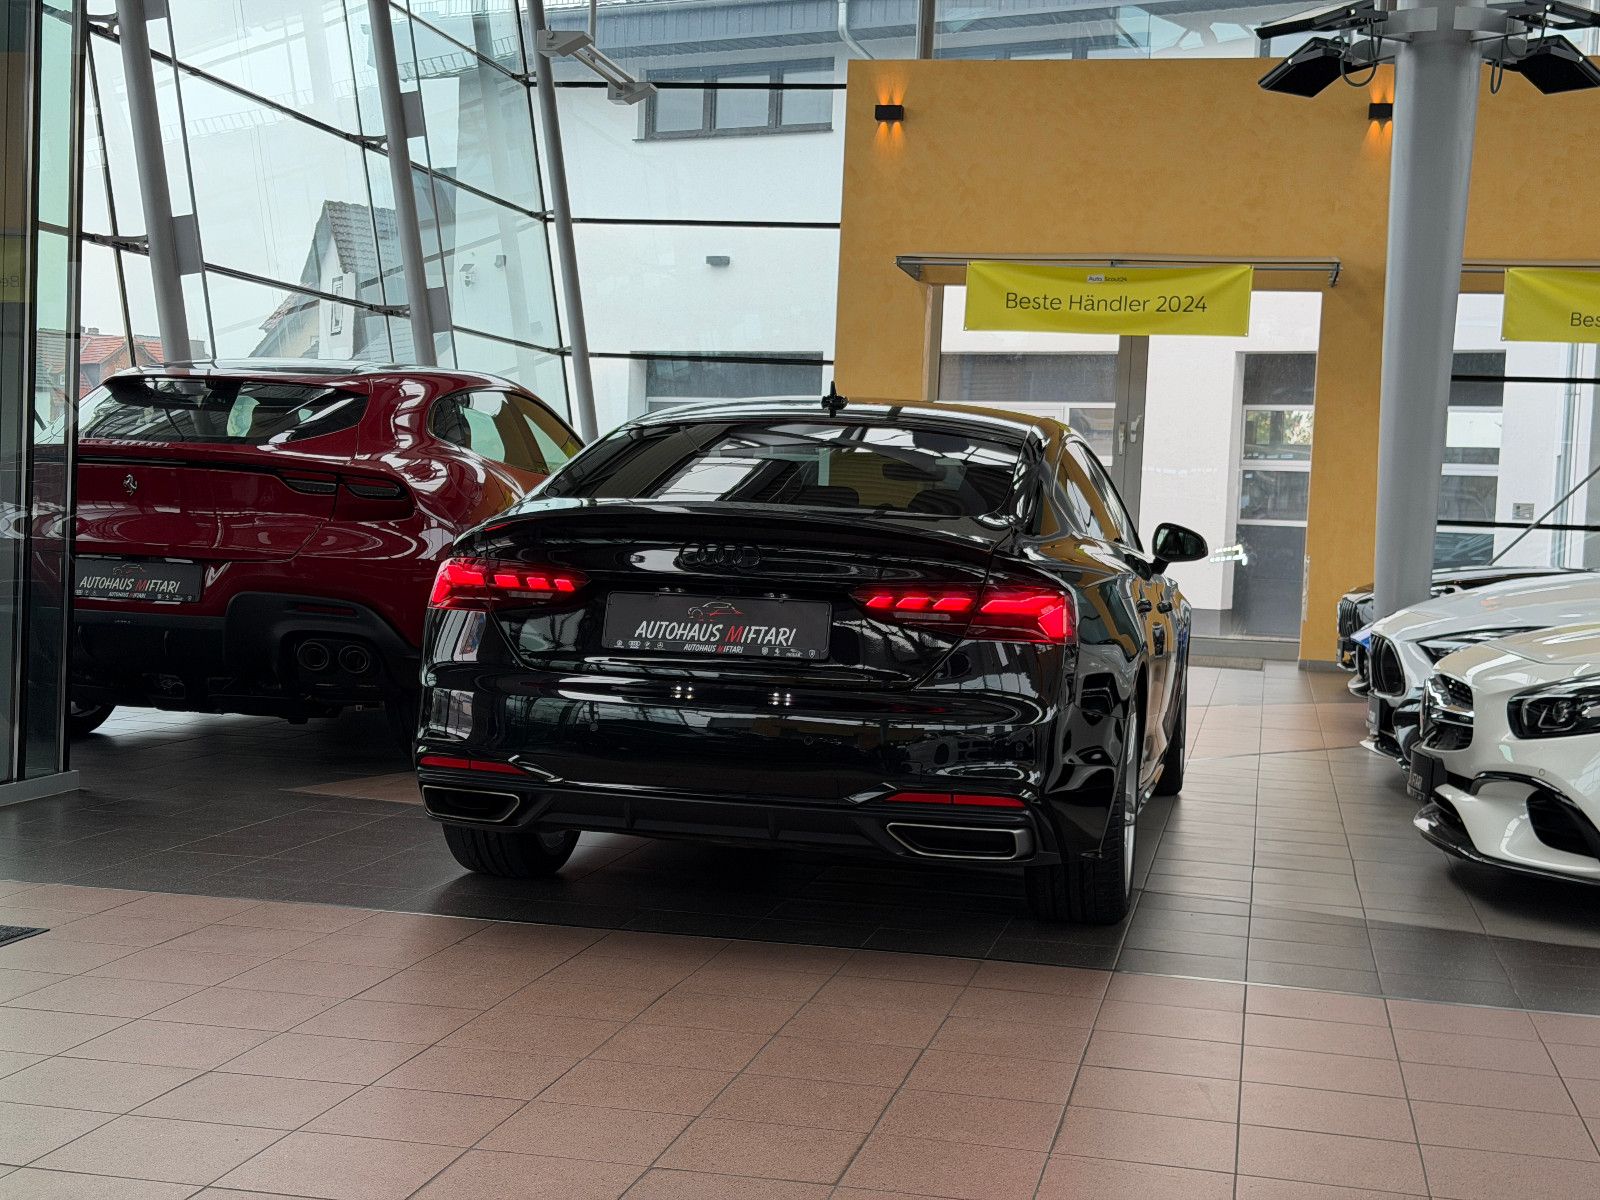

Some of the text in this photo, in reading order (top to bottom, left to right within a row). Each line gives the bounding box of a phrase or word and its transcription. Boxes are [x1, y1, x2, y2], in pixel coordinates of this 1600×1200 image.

[1005, 292, 1208, 313] Beste Händler 2024
[79, 576, 180, 593] AUTOHAUS MIFTARI
[635, 621, 797, 647] AUTOHAUS MIFTARI
[684, 644, 717, 653] AUTOHAUS
[717, 646, 743, 654] MIFTARI
